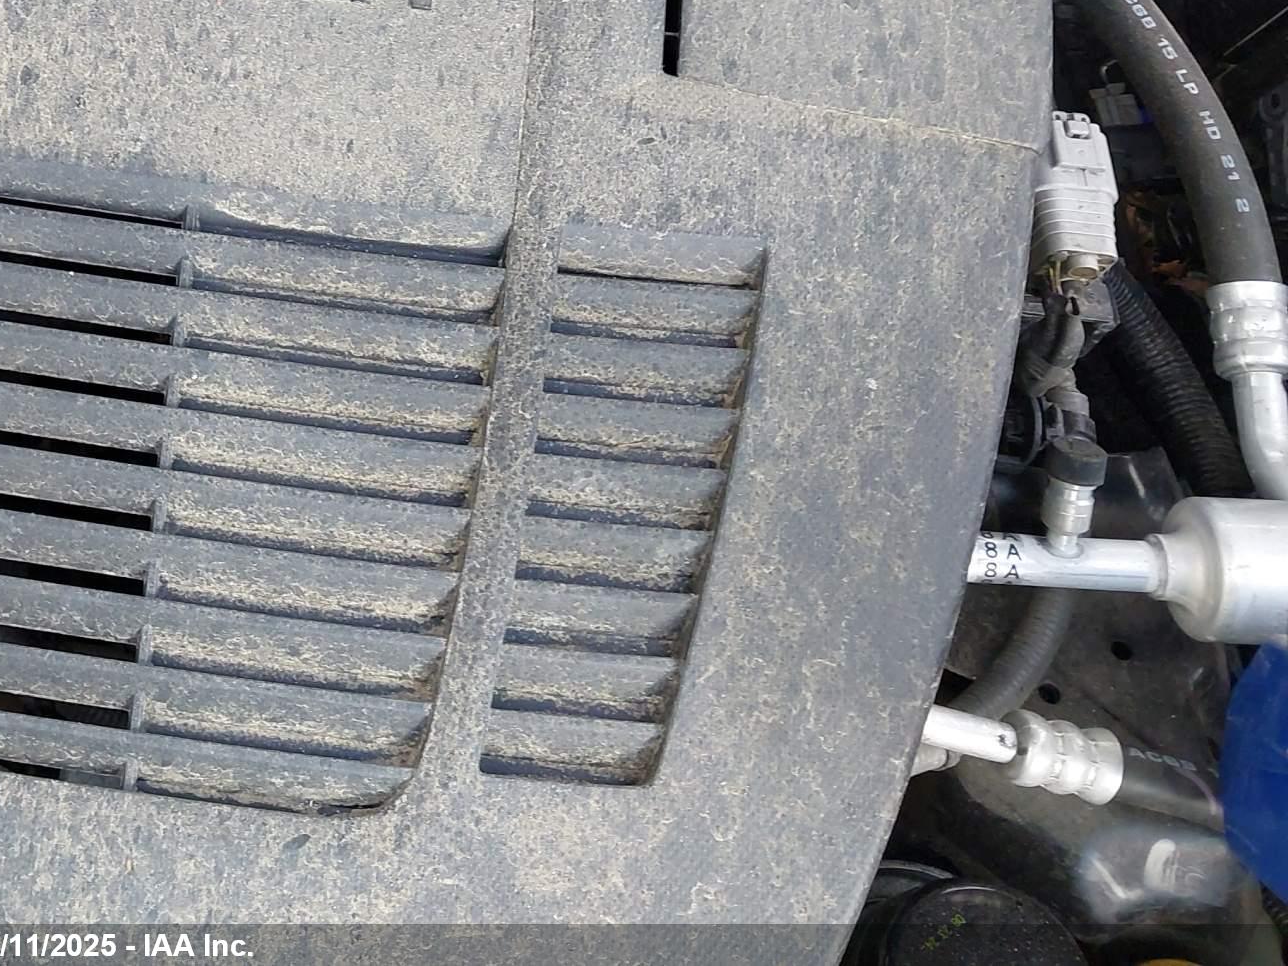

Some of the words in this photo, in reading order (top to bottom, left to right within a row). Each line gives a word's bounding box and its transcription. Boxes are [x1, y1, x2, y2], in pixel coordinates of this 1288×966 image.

[1157, 35, 1179, 61] 15
[1175, 68, 1200, 96] LP
[1199, 110, 1222, 141] HD
[1220, 153, 1241, 181] 21
[1234, 197, 1251, 213] 2
